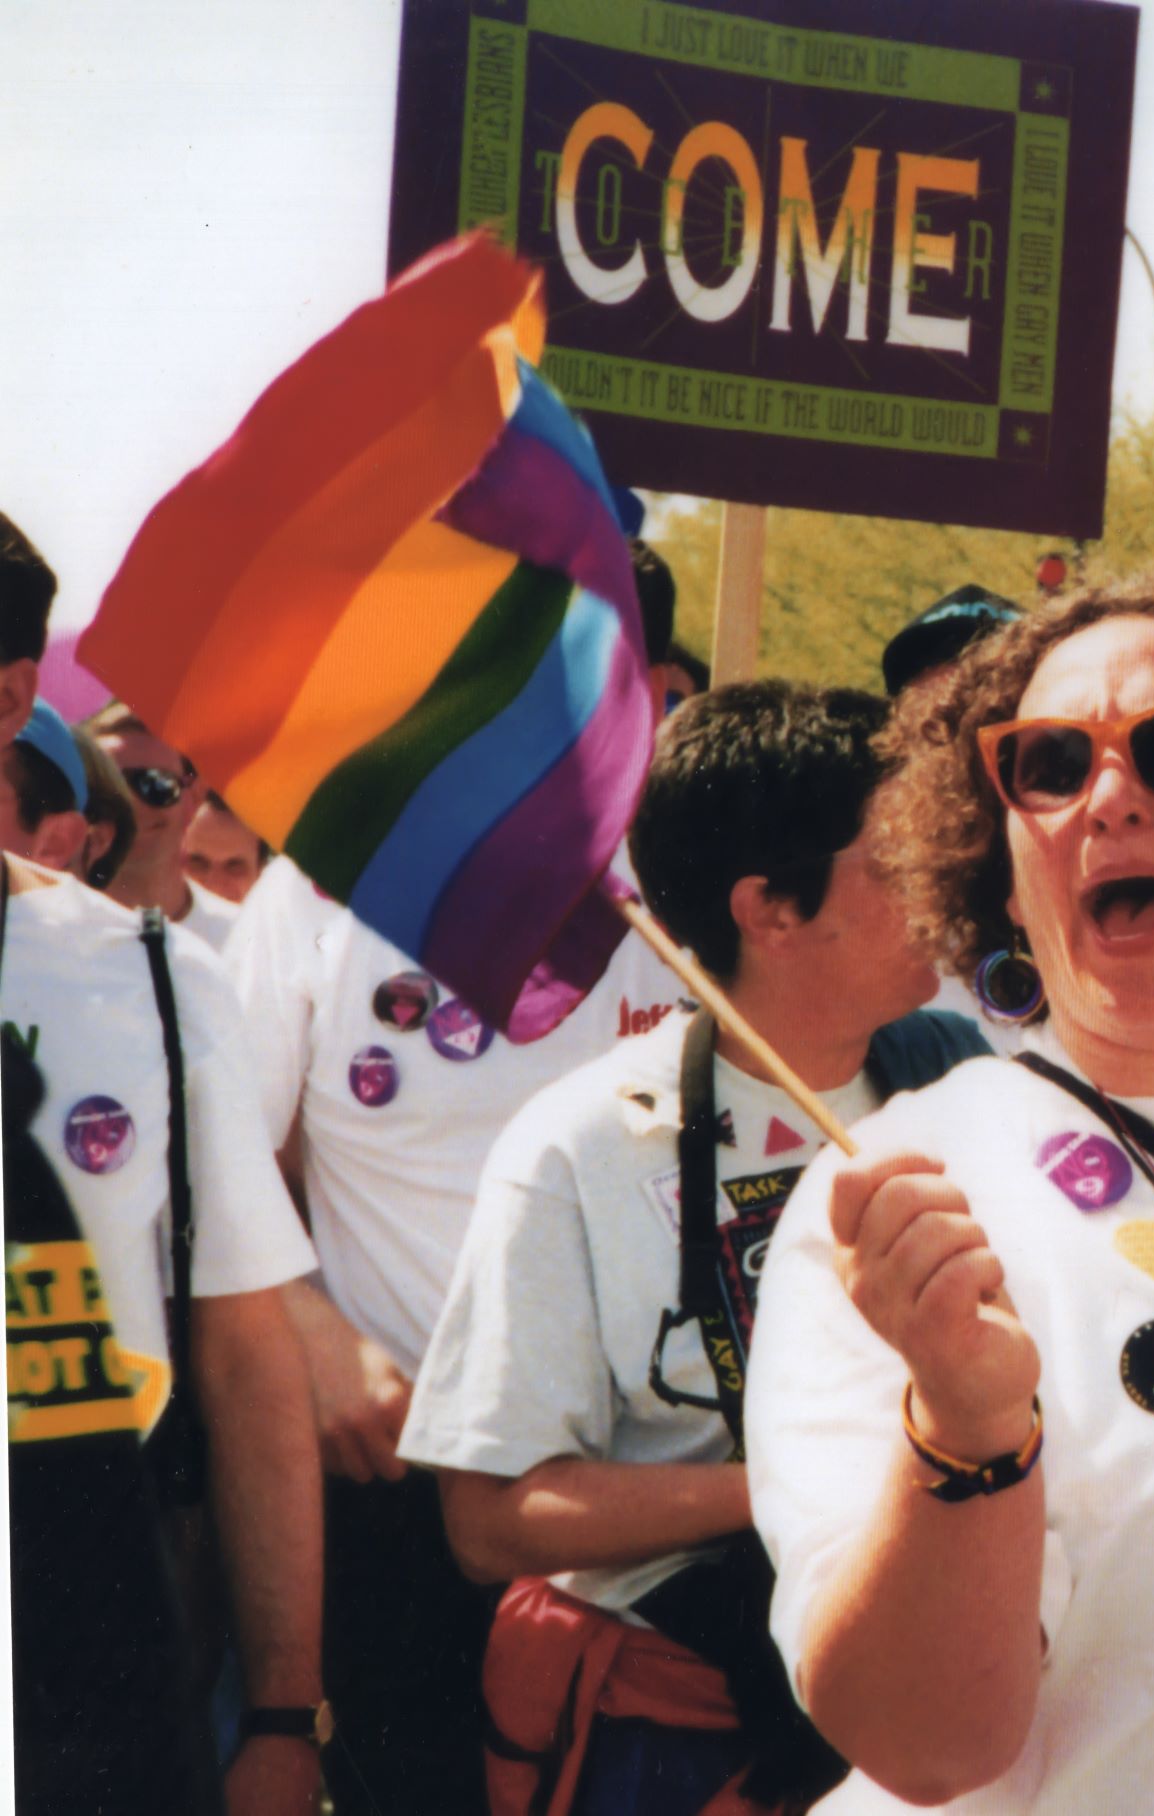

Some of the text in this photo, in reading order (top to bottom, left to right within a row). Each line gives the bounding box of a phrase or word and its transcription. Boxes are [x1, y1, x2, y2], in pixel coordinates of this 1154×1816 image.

[655, 11, 712, 57] JUST
[717, 22, 769, 69] LOVE
[777, 36, 798, 74] IT
[804, 39, 869, 82] WHEN
[876, 49, 908, 88] WE
[475, 29, 516, 142] LESBIANS
[1022, 144, 1059, 200] LOVE
[535, 150, 994, 300] TOGETHER
[556, 101, 981, 357] COME
[1020, 203, 1056, 227] IT
[1016, 232, 1055, 297] WHEN
[1012, 303, 1050, 347] GAY
[546, 352, 987, 448] OULDN'T IT BE NICE IF THE WORLD WOULD
[1009, 347, 1045, 398] MEN
[728, 1176, 787, 1202] TASK
